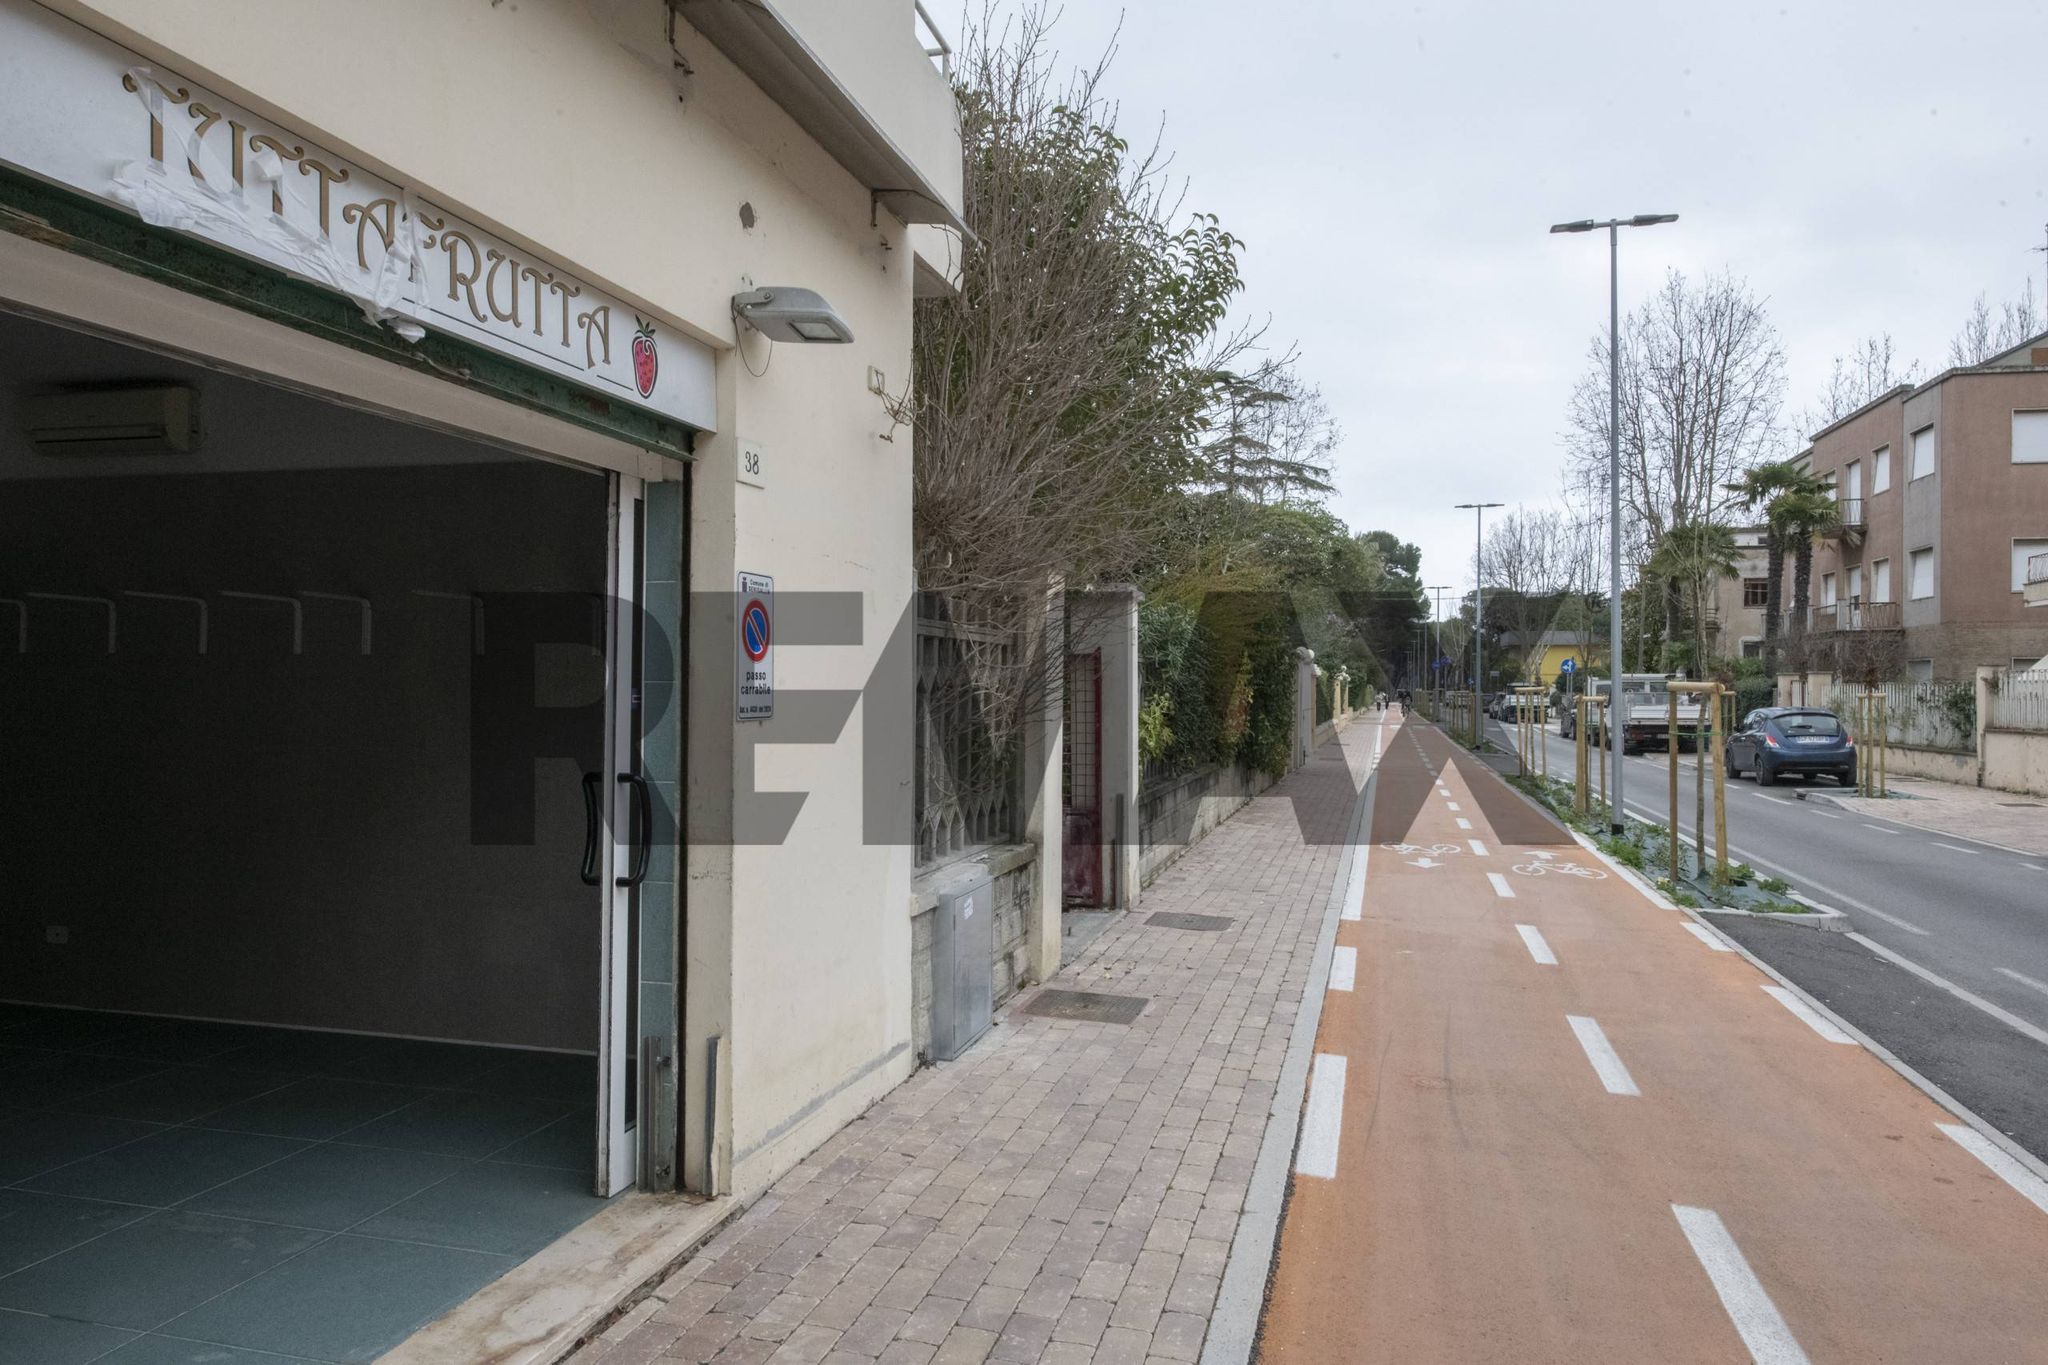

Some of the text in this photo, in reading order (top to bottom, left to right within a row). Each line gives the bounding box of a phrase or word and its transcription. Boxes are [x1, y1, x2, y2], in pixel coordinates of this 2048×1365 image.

[745, 451, 760, 475] 38
[746, 671, 766, 683] passo
[741, 683, 771, 695] carrabile
